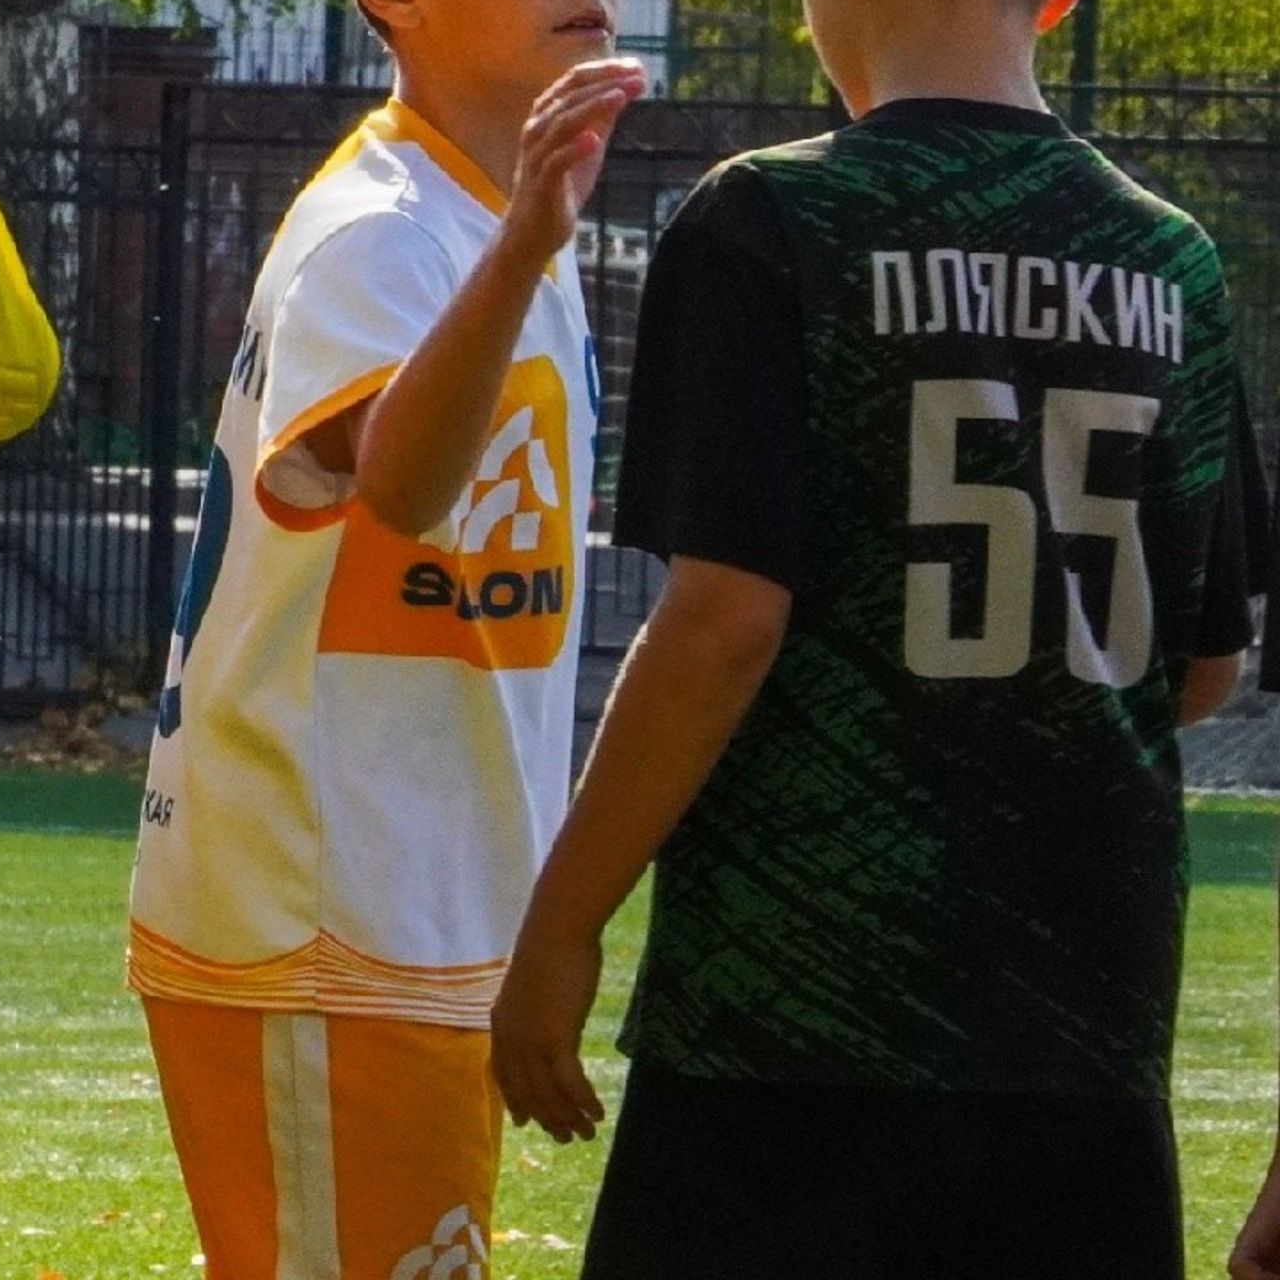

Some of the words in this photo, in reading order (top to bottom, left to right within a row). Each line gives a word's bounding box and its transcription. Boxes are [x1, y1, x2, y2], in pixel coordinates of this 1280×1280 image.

[871, 247, 1184, 364] ПЛЯСКИН
[400, 562, 564, 621] SLON
[903, 378, 1162, 690] 55
